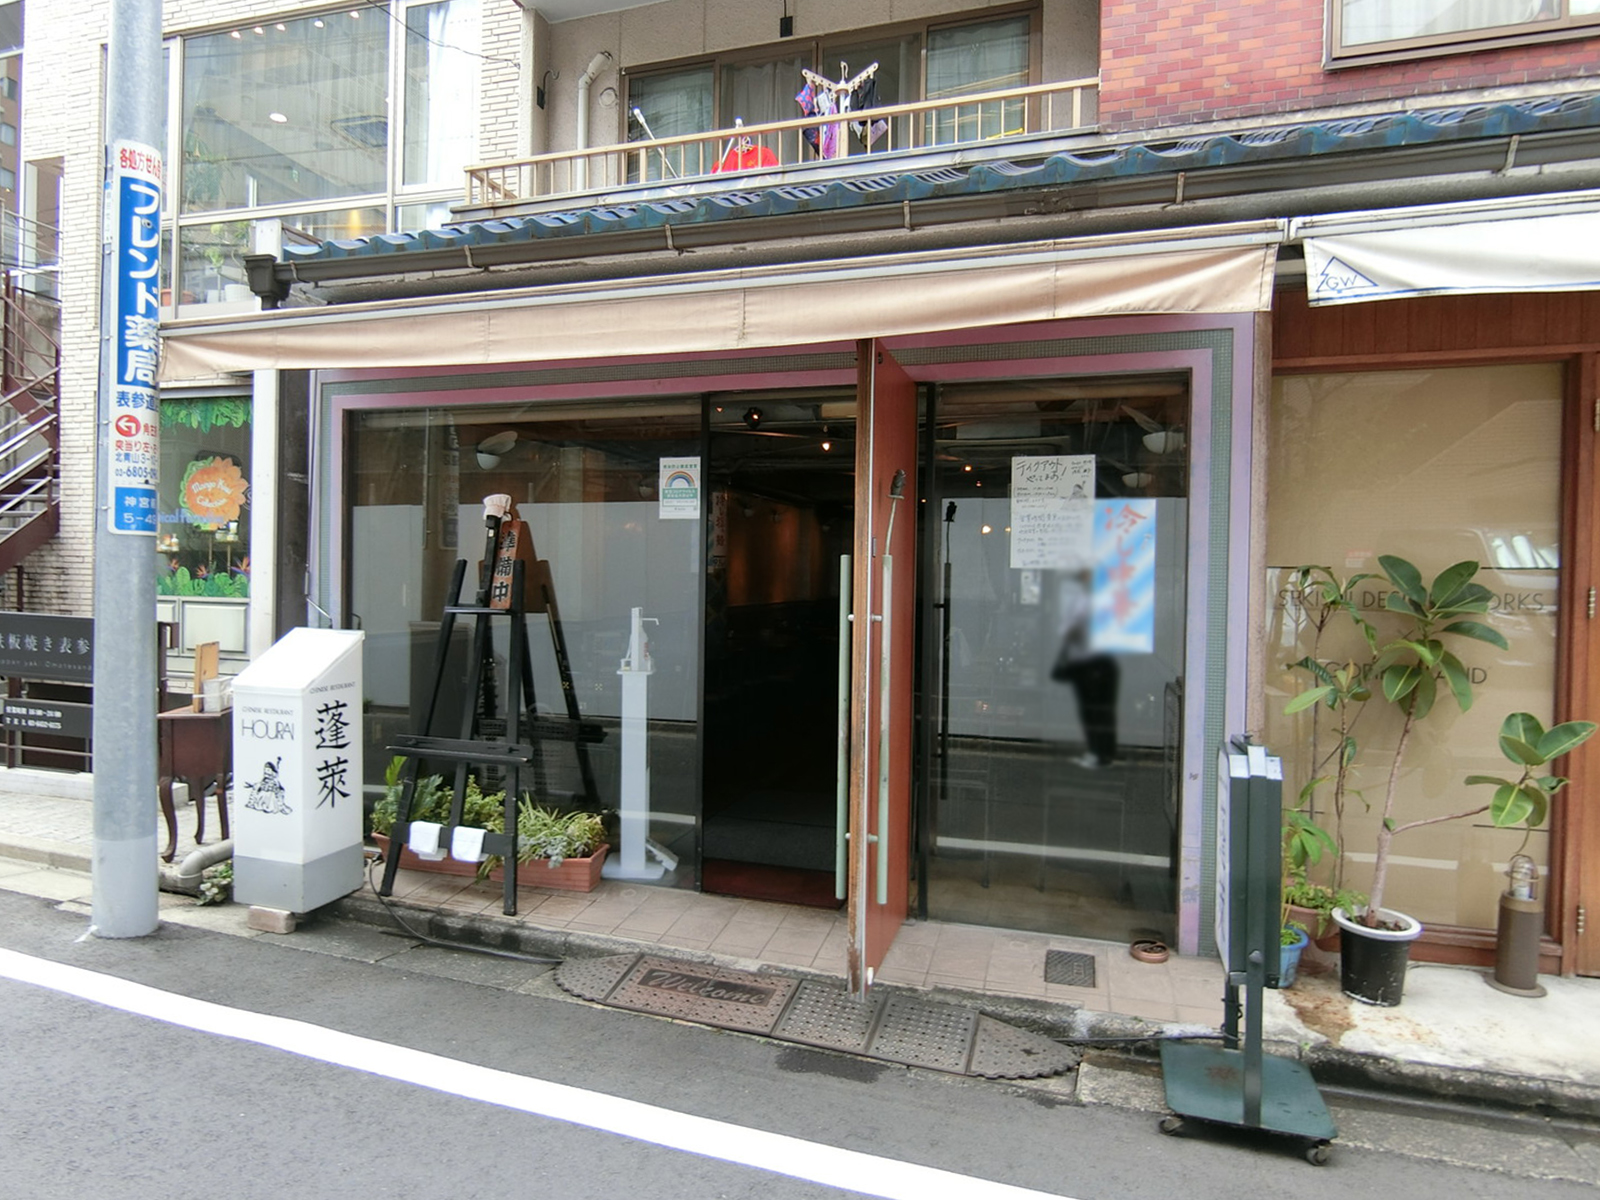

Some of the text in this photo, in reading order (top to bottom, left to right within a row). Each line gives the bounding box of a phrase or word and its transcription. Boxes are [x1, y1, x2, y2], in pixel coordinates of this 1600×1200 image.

[124, 183, 160, 385] フレンド薬局
[492, 530, 516, 603] 準備中
[649, 971, 767, 1004] Welcome
